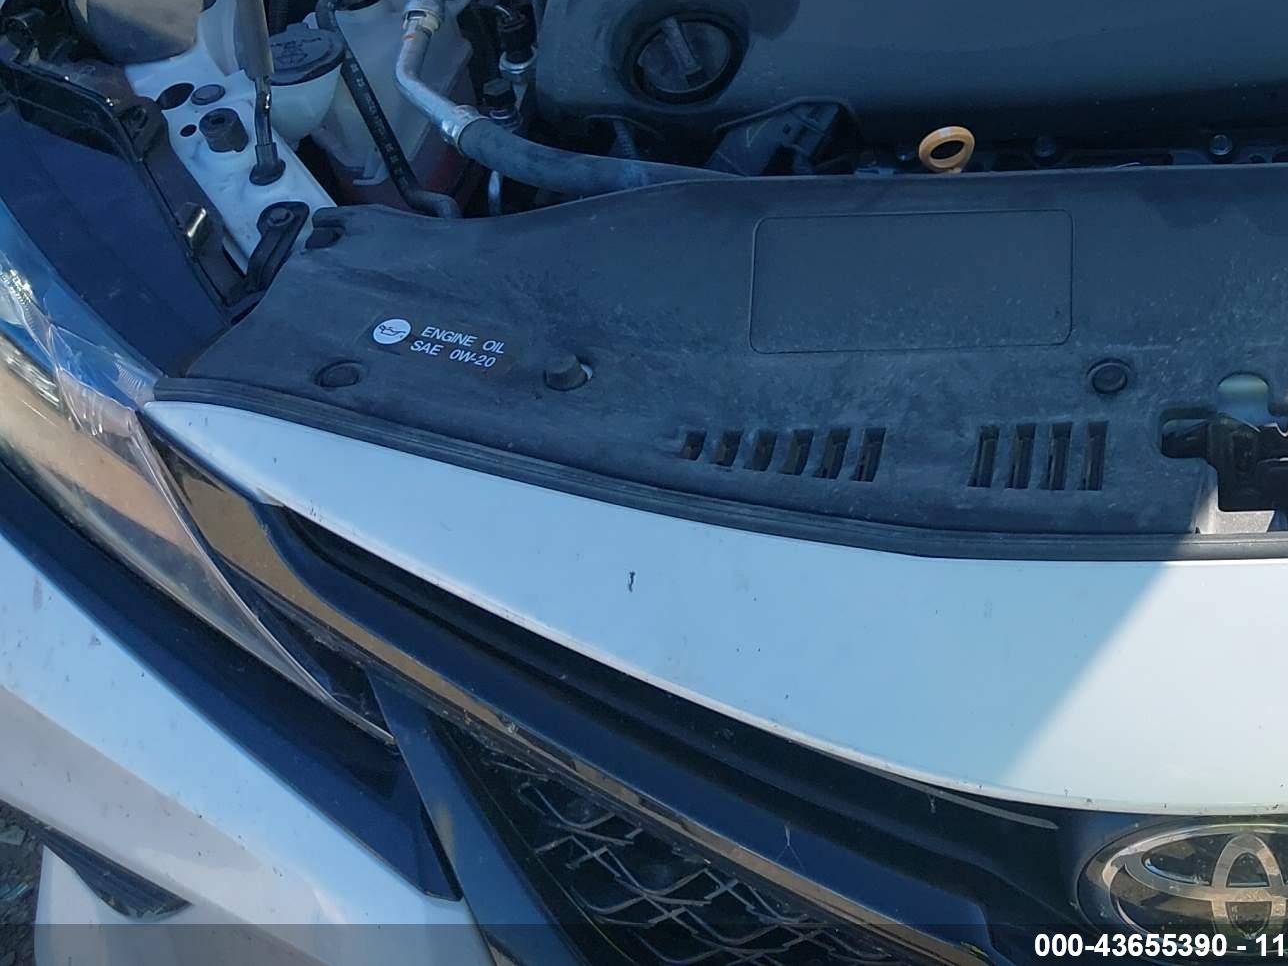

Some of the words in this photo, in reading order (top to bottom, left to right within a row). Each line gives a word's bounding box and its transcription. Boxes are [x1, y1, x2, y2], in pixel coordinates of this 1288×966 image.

[410, 340, 444, 356] SAE
[449, 349, 496, 368] 0W-20
[421, 326, 478, 347] ENGINE
[482, 340, 505, 354] OIL
